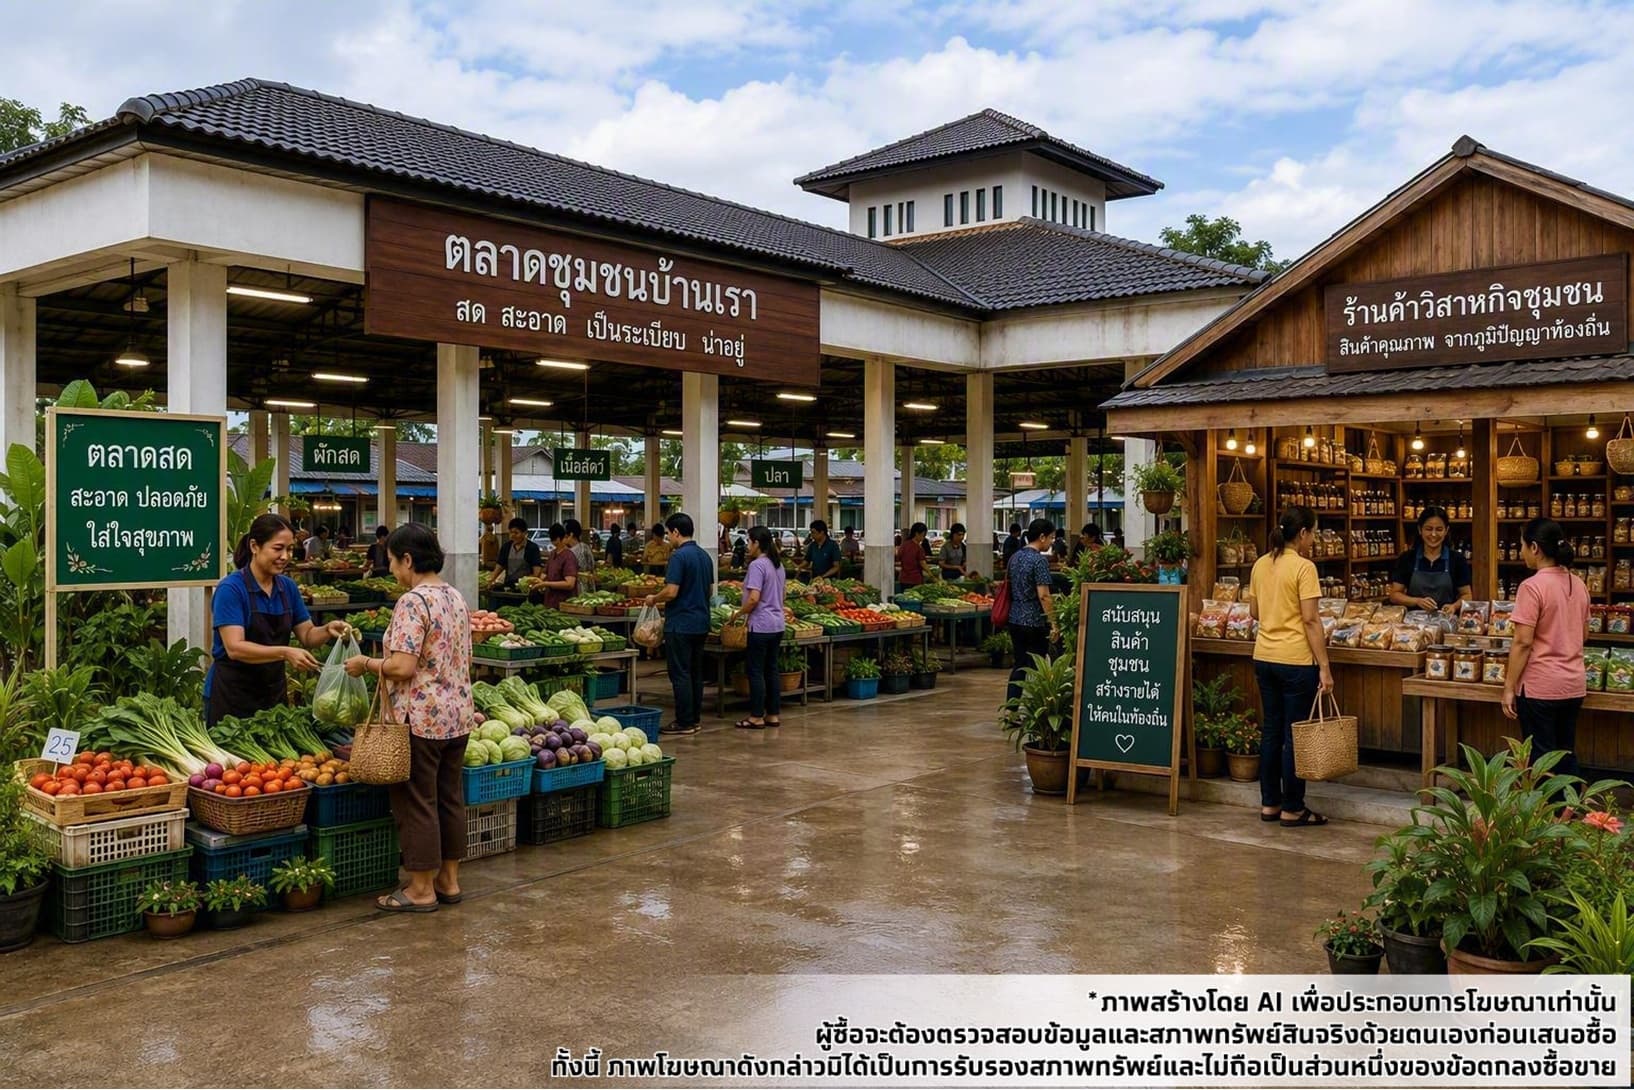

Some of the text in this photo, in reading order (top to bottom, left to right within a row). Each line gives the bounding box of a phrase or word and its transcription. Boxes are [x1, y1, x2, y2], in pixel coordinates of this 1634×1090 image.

[444, 233, 758, 321] ตลาดชุมชนบ้านเรา
[1343, 281, 1604, 327] ร้านค้าวิสาหกิจชุมชน
[456, 299, 746, 368] สด สะอาด เป็นระเบียบ น่าอยู่
[1339, 312, 1611, 359] สินค้าคุณภาพ จากภูมิปัญญาท้องถิ่น
[87, 443, 193, 470] ตลาดสด
[313, 442, 361, 465] ผักสด
[560, 452, 605, 475] เนื้อสัตว์
[764, 465, 790, 483] ปลา
[70, 484, 208, 508] สะอาด ปลอดภัย
[86, 520, 194, 557] ใส่ใจสุขภาพ
[1101, 604, 1161, 629] สนับสนุน
[1111, 630, 1149, 650] สินค้า
[1108, 656, 1150, 677] ชุมชน
[1095, 679, 1161, 700] สร้างรายได้
[1087, 703, 1168, 727] ให้คนในท้องถิ่น
[49, 735, 74, 756] 25
